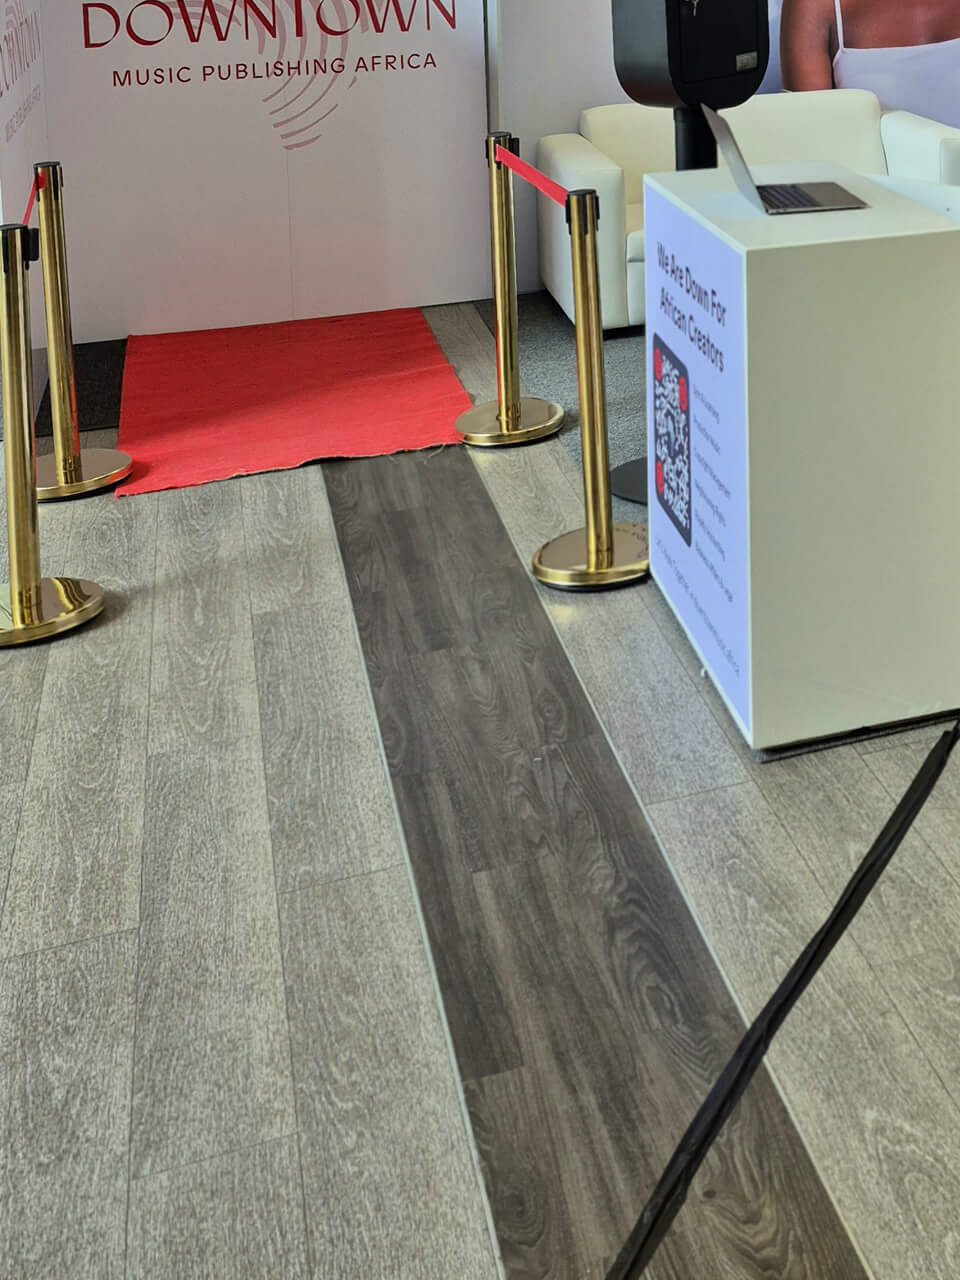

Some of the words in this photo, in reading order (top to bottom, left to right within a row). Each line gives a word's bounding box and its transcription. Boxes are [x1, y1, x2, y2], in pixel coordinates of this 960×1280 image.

[112, 66, 192, 88] MUSIC
[202, 57, 346, 82] PUBLISHING
[354, 52, 437, 73] AFRICA
[656, 240, 669, 275] We
[670, 253, 684, 288] Are
[685, 266, 709, 312] Down
[711, 289, 727, 327] For
[659, 287, 687, 336] African
[687, 314, 725, 373] Creators
